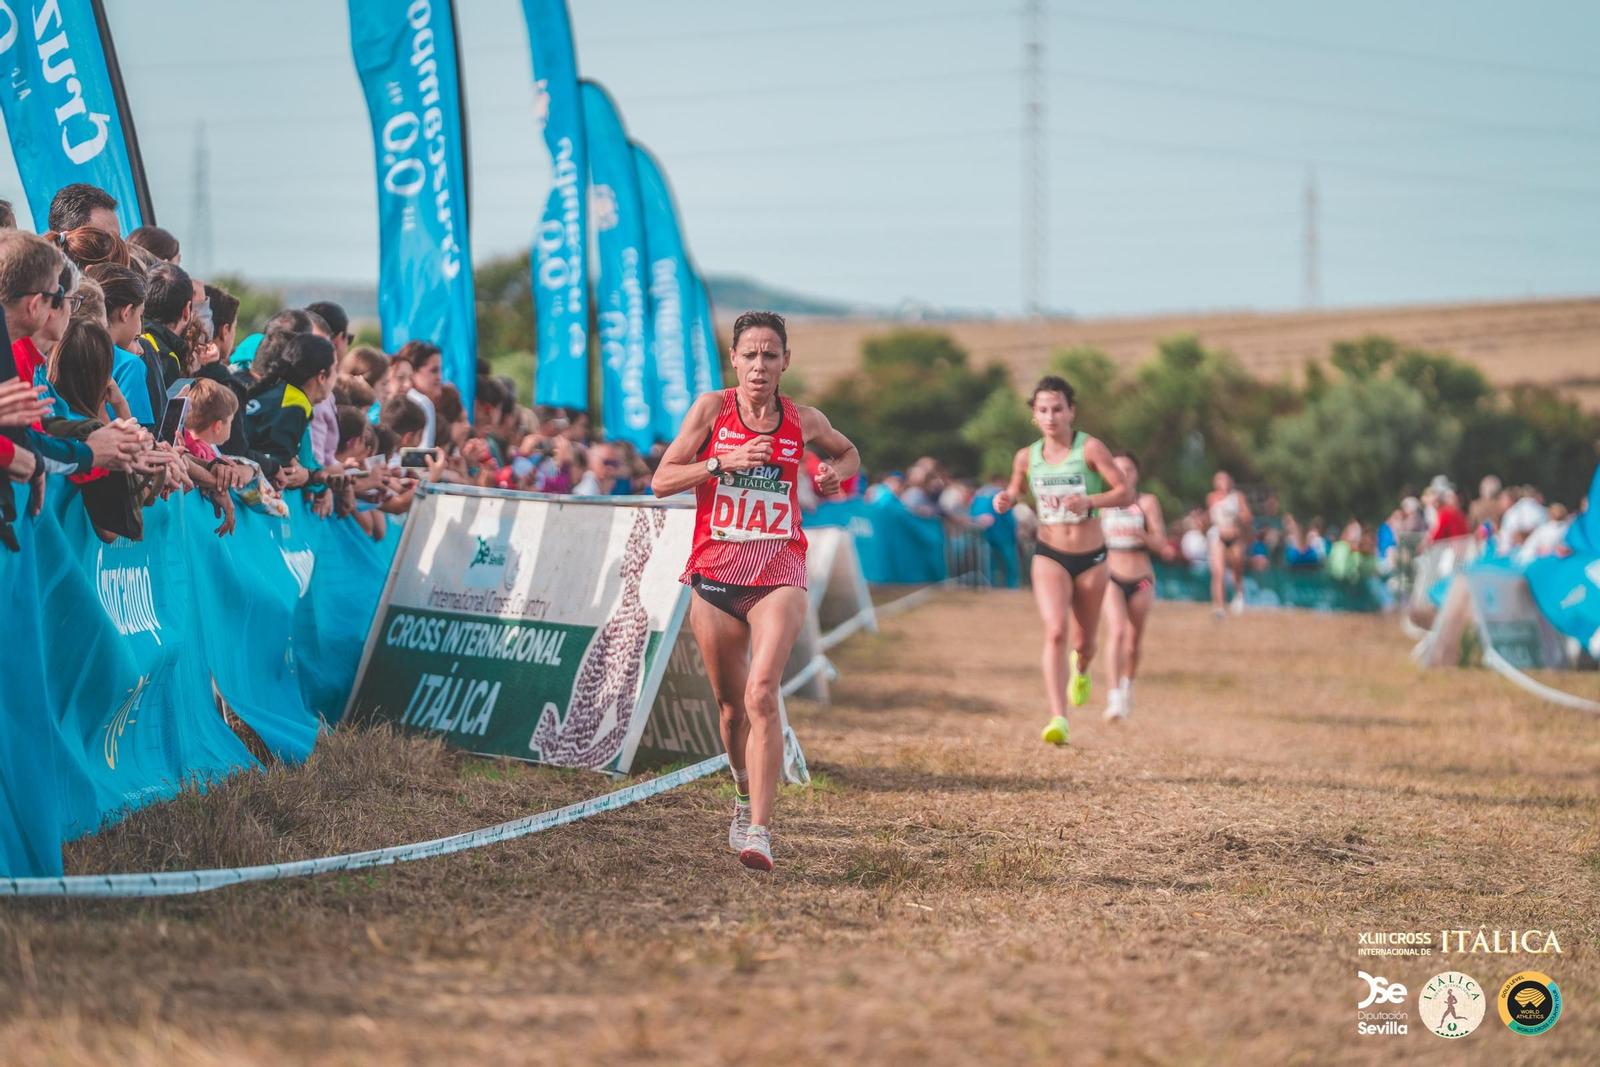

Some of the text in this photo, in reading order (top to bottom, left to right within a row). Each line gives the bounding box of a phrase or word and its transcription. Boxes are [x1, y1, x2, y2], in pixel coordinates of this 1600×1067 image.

[719, 427, 745, 440] Bilbao
[712, 489, 789, 535] DÍAZ
[386, 613, 567, 666] CROSS INTERNACIONAL
[400, 661, 502, 736] ITÁLICA
